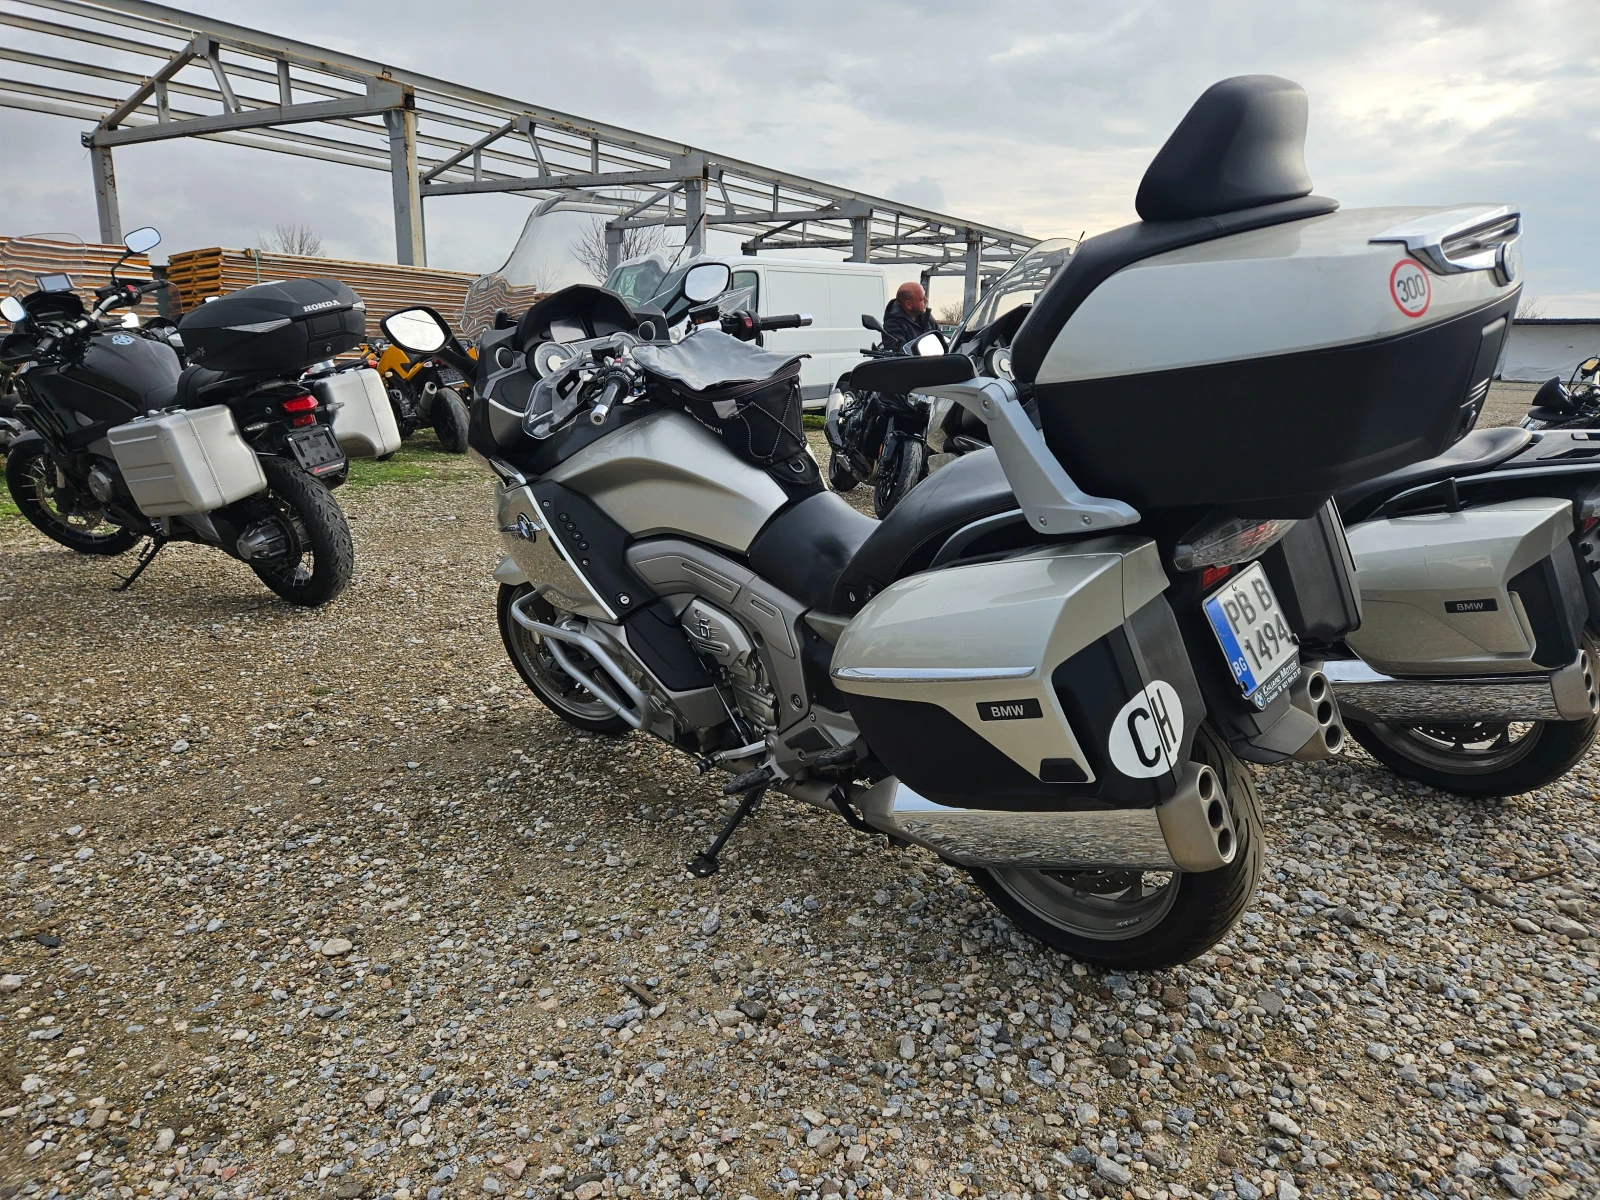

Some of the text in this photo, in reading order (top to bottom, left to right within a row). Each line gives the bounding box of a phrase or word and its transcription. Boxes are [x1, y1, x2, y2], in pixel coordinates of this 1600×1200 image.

[1397, 274, 1426, 303] 300
[303, 300, 341, 312] HONDA
[1223, 577, 1273, 635] PB B
[1456, 602, 1484, 611] BMW
[1243, 611, 1292, 671] 1494
[1233, 657, 1247, 677] BG
[990, 704, 1024, 717] BMW
[1127, 688, 1178, 768] CH
